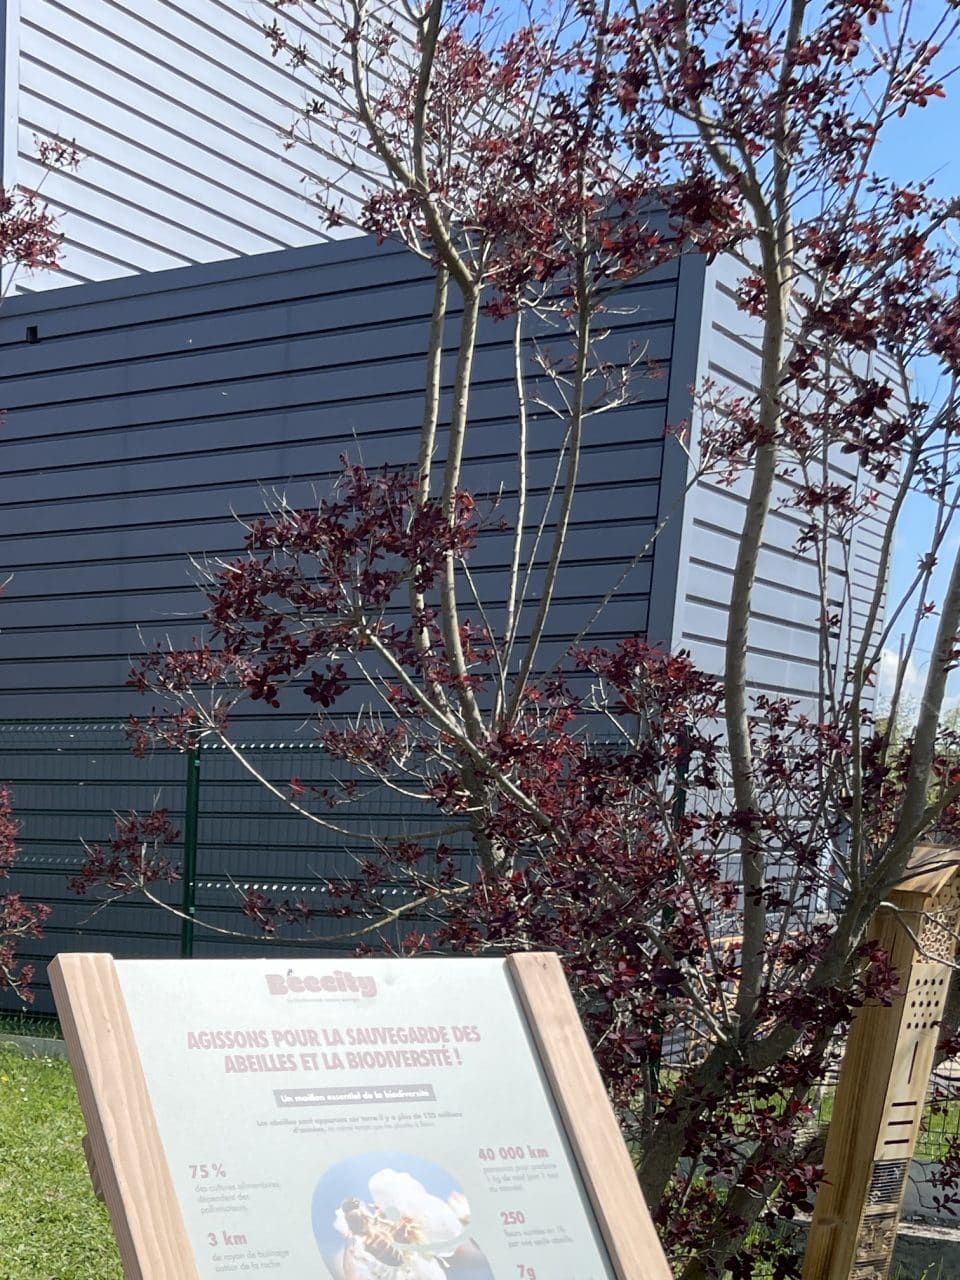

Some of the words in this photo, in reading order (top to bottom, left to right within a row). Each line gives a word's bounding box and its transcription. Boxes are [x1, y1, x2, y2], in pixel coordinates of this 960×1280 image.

[265, 970, 377, 998] Beecity
[187, 1030, 270, 1050] AGISSONS
[271, 1029, 322, 1047] POUR
[322, 1028, 345, 1046] LA
[346, 1026, 450, 1045] SAUVEGARDE
[451, 1025, 481, 1042] DES
[224, 1053, 298, 1073] ABEILLES
[299, 1052, 320, 1070] ET
[321, 1051, 345, 1070] LA
[345, 1044, 453, 1069] BIODIVERSITÉ
[453, 1047, 463, 1066] !
[280, 1093, 294, 1103] Un
[294, 1092, 326, 1102] maillon
[327, 1090, 362, 1101] essentiel
[362, 1090, 374, 1100] de
[374, 1090, 383, 1099] la
[478, 1147, 496, 1161] 40
[498, 1145, 525, 1160] 000
[526, 1144, 549, 1159] km
[189, 1164, 209, 1179] 75
[211, 1162, 227, 1178] %
[501, 1210, 526, 1226] 250
[207, 1231, 218, 1247] 3
[222, 1229, 248, 1246] km
[516, 1264, 525, 1279] 7
[526, 1267, 537, 1280] g
